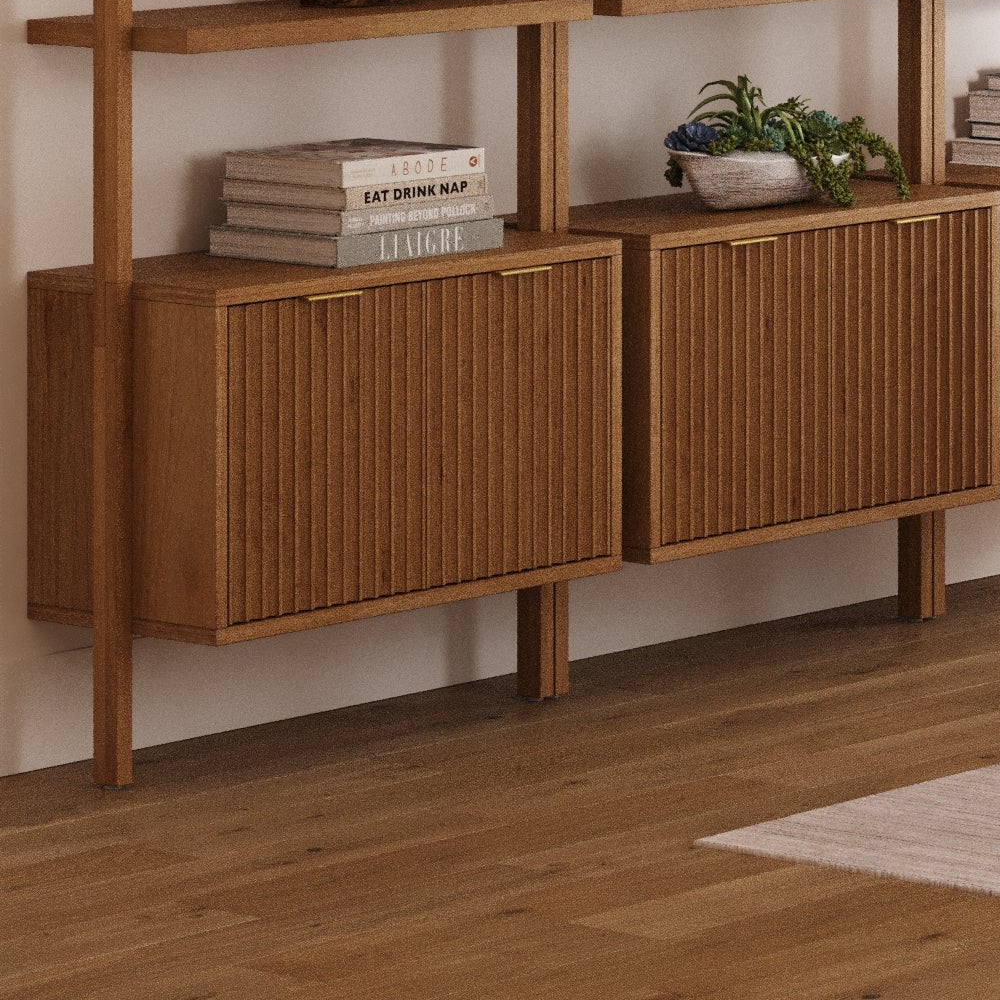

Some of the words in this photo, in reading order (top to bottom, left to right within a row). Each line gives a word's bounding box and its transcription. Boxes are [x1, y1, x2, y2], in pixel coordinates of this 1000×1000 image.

[391, 157, 448, 177] ABODE
[364, 190, 389, 204] EAT
[393, 184, 436, 200] DRINK
[440, 180, 468, 195] NAP
[369, 211, 406, 226] PAINTING
[408, 206, 439, 222] BEYOND
[441, 202, 477, 217] POLLOCK
[379, 226, 464, 260] LIAIGRE
